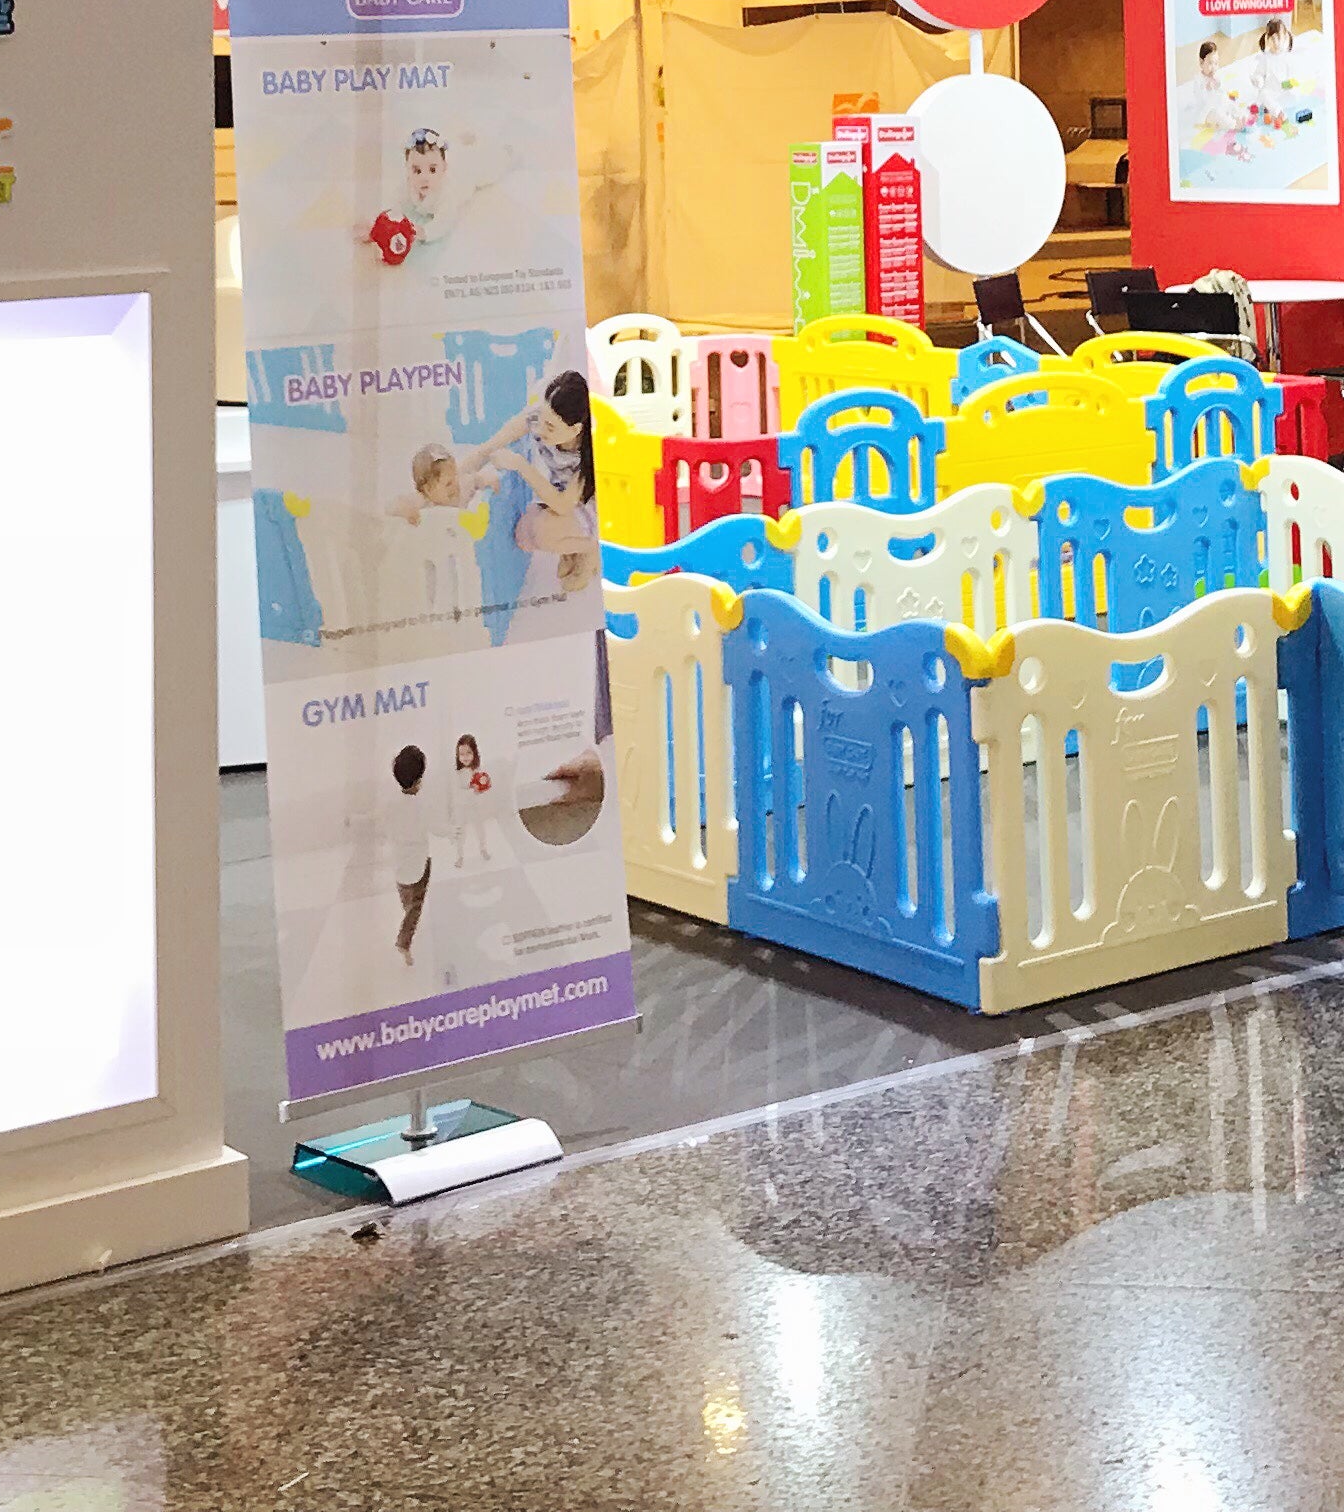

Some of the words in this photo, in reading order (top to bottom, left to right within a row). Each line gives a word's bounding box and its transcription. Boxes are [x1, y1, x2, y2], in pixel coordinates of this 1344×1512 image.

[262, 69, 326, 95] BABY
[334, 66, 391, 92] PLAY
[399, 64, 451, 90] MAT
[287, 372, 352, 404] BABY
[359, 363, 463, 396] PLAYPEN
[302, 691, 366, 727] GYM
[374, 681, 430, 716] MAT
